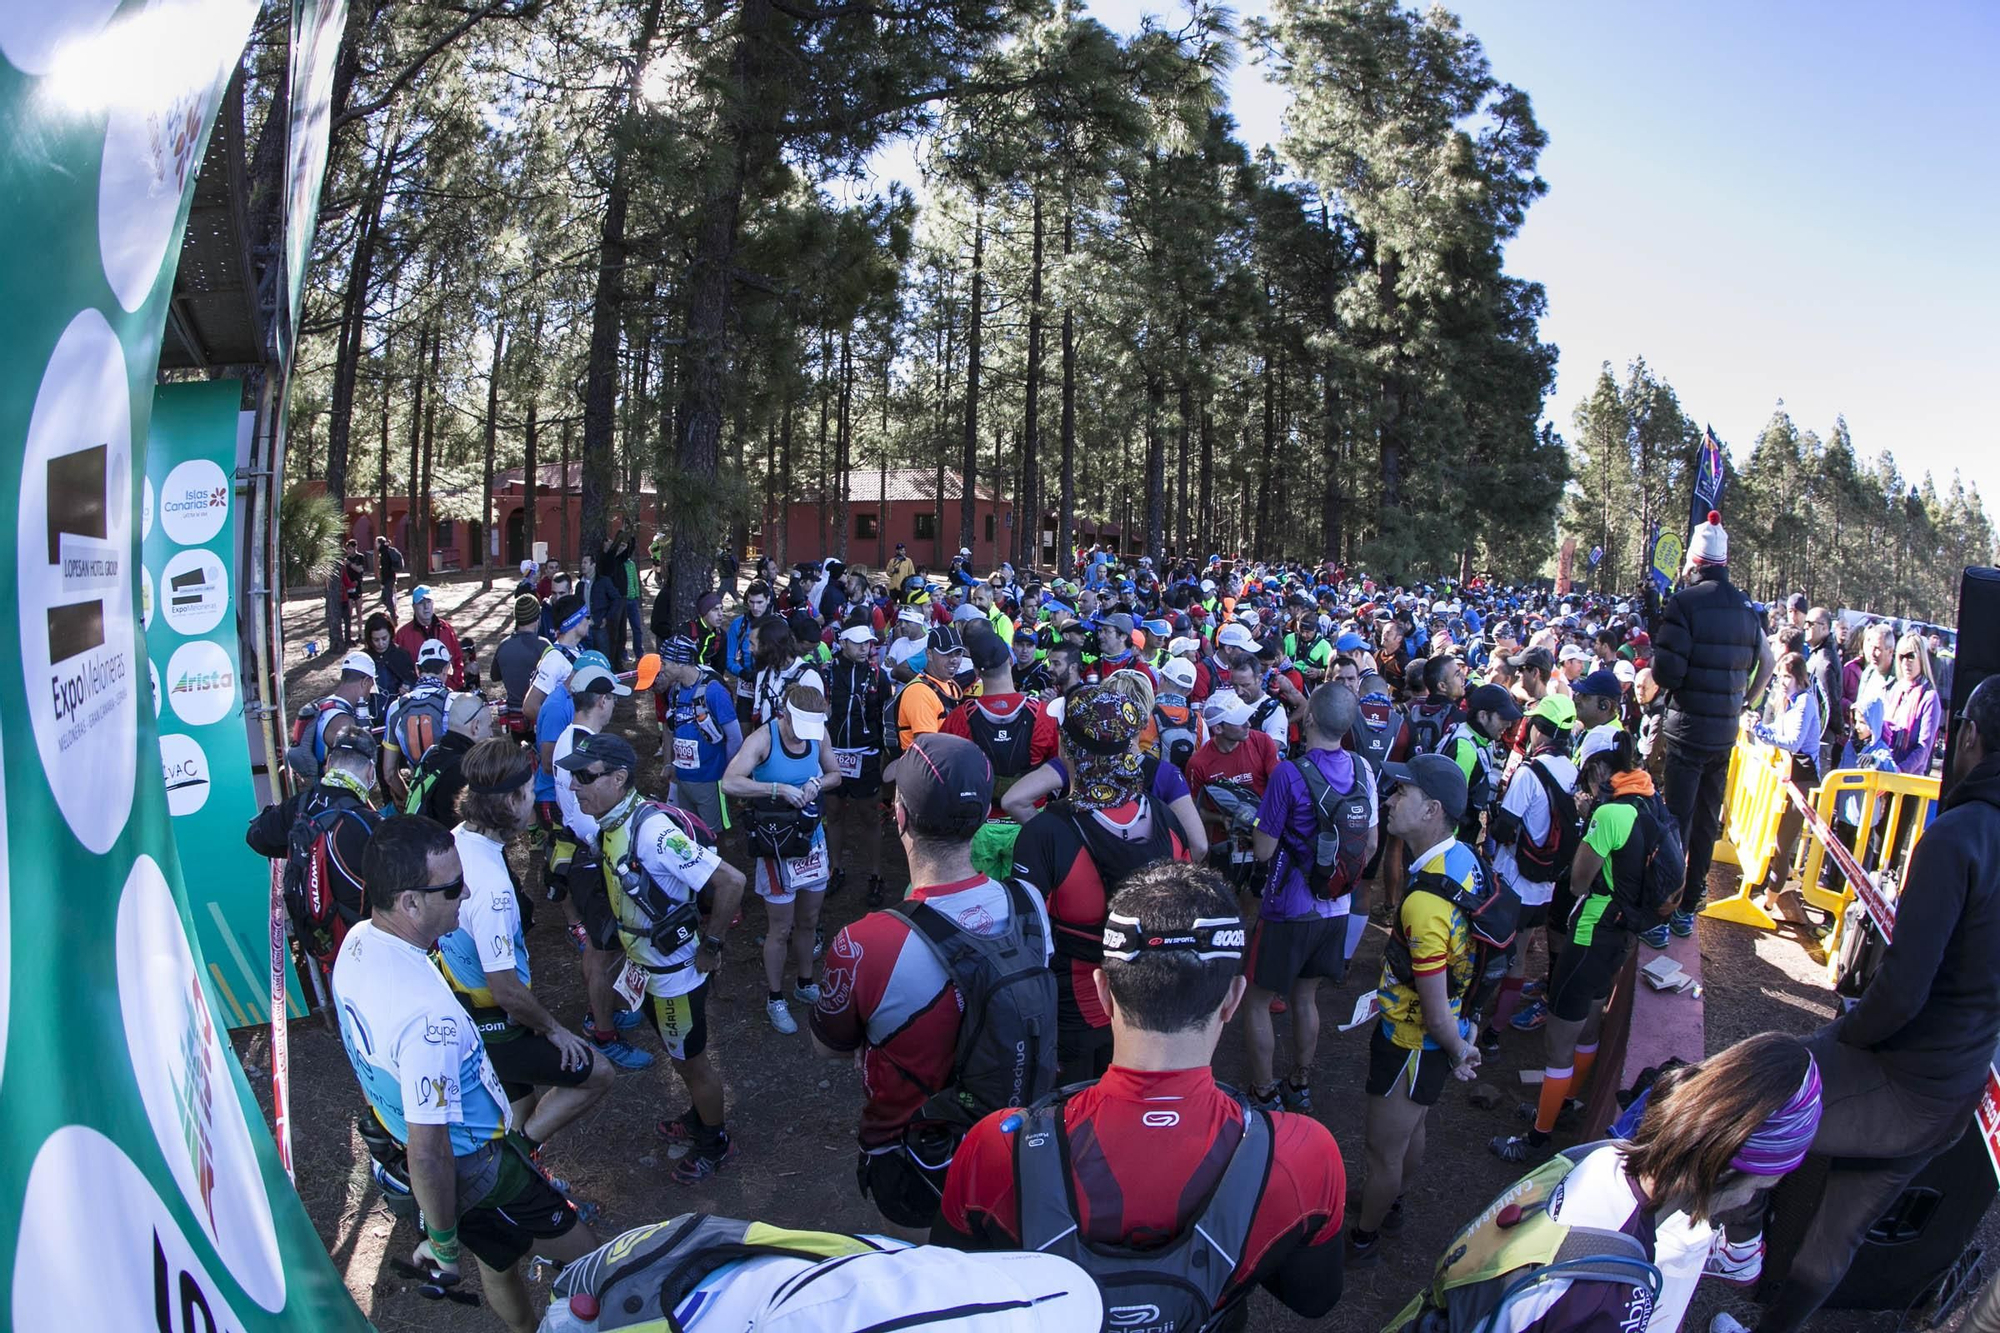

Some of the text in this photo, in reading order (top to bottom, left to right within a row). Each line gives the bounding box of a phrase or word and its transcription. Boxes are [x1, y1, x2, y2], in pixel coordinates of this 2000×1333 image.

[164, 500, 208, 512] Canarias
[186, 489, 208, 500] Islas
[64, 559, 119, 578] LOPESAN HOTEL GROUP
[52, 652, 125, 723] ExpoMeloneras
[171, 670, 233, 695] Arista
[310, 846, 322, 914] SALOM
[834, 983, 850, 1008] TOUR
[1008, 1040, 1026, 1108] Quechua
[1467, 1179, 1534, 1238] CAMELBAK
